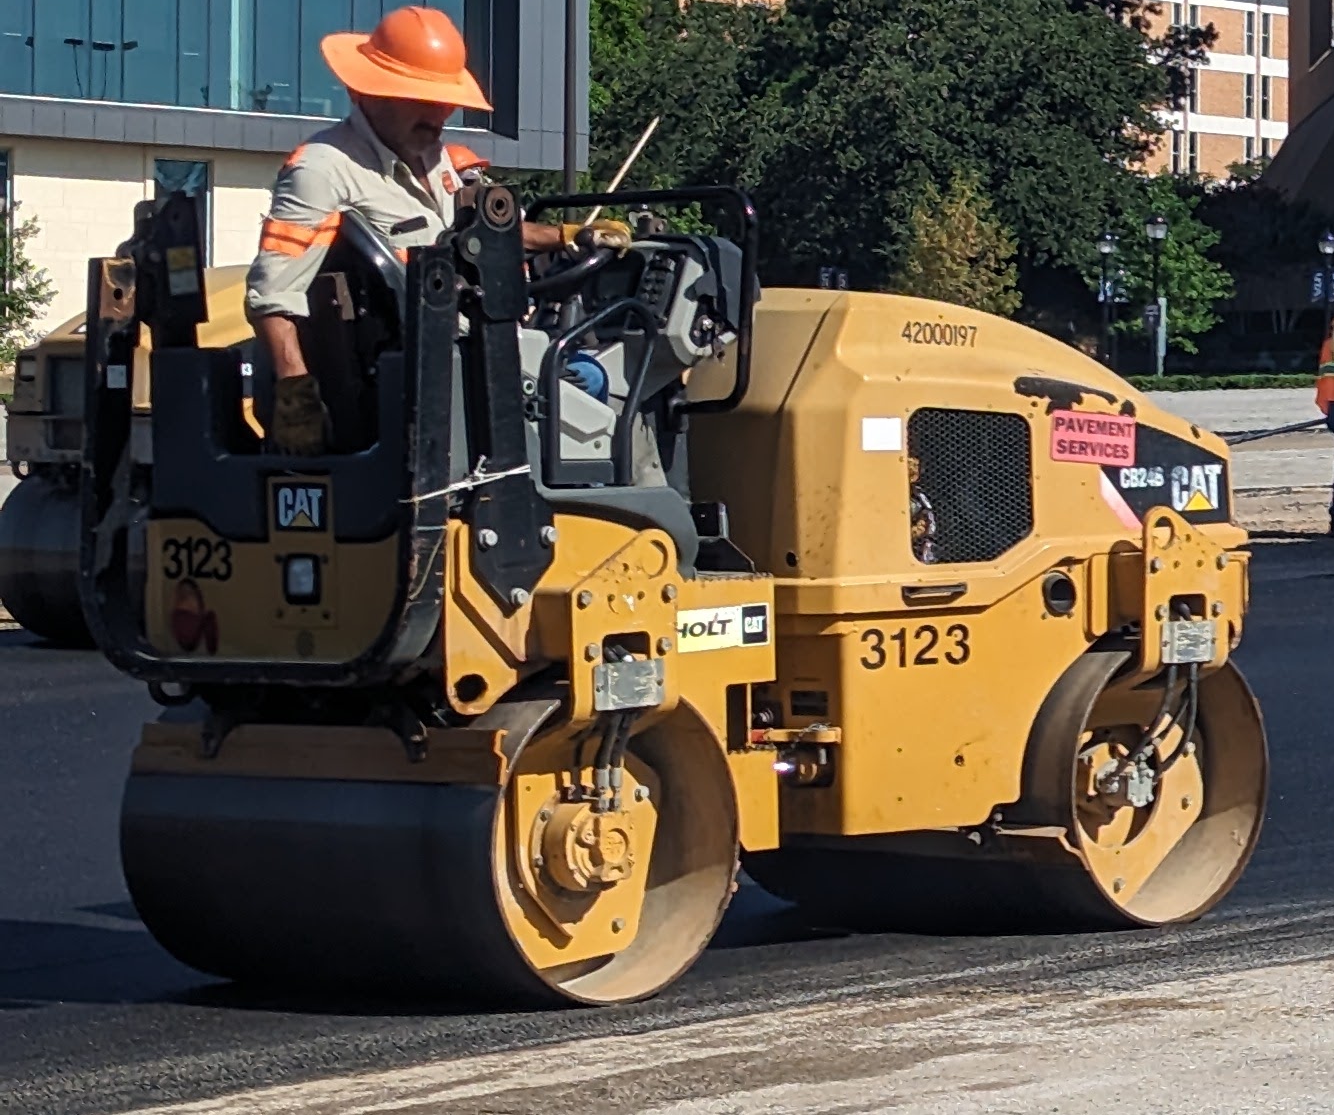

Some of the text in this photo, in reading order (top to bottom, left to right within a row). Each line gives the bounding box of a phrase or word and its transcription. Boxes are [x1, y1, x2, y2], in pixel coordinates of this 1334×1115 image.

[901, 321, 977, 348] 42000197
[1054, 417, 1133, 438] PAVEMENT
[1056, 439, 1130, 460] SERVICES
[1171, 464, 1223, 512] CAT
[278, 487, 323, 527] CAT
[163, 537, 233, 580] 3123
[676, 619, 733, 638] HOLT
[860, 623, 971, 670] 3123
